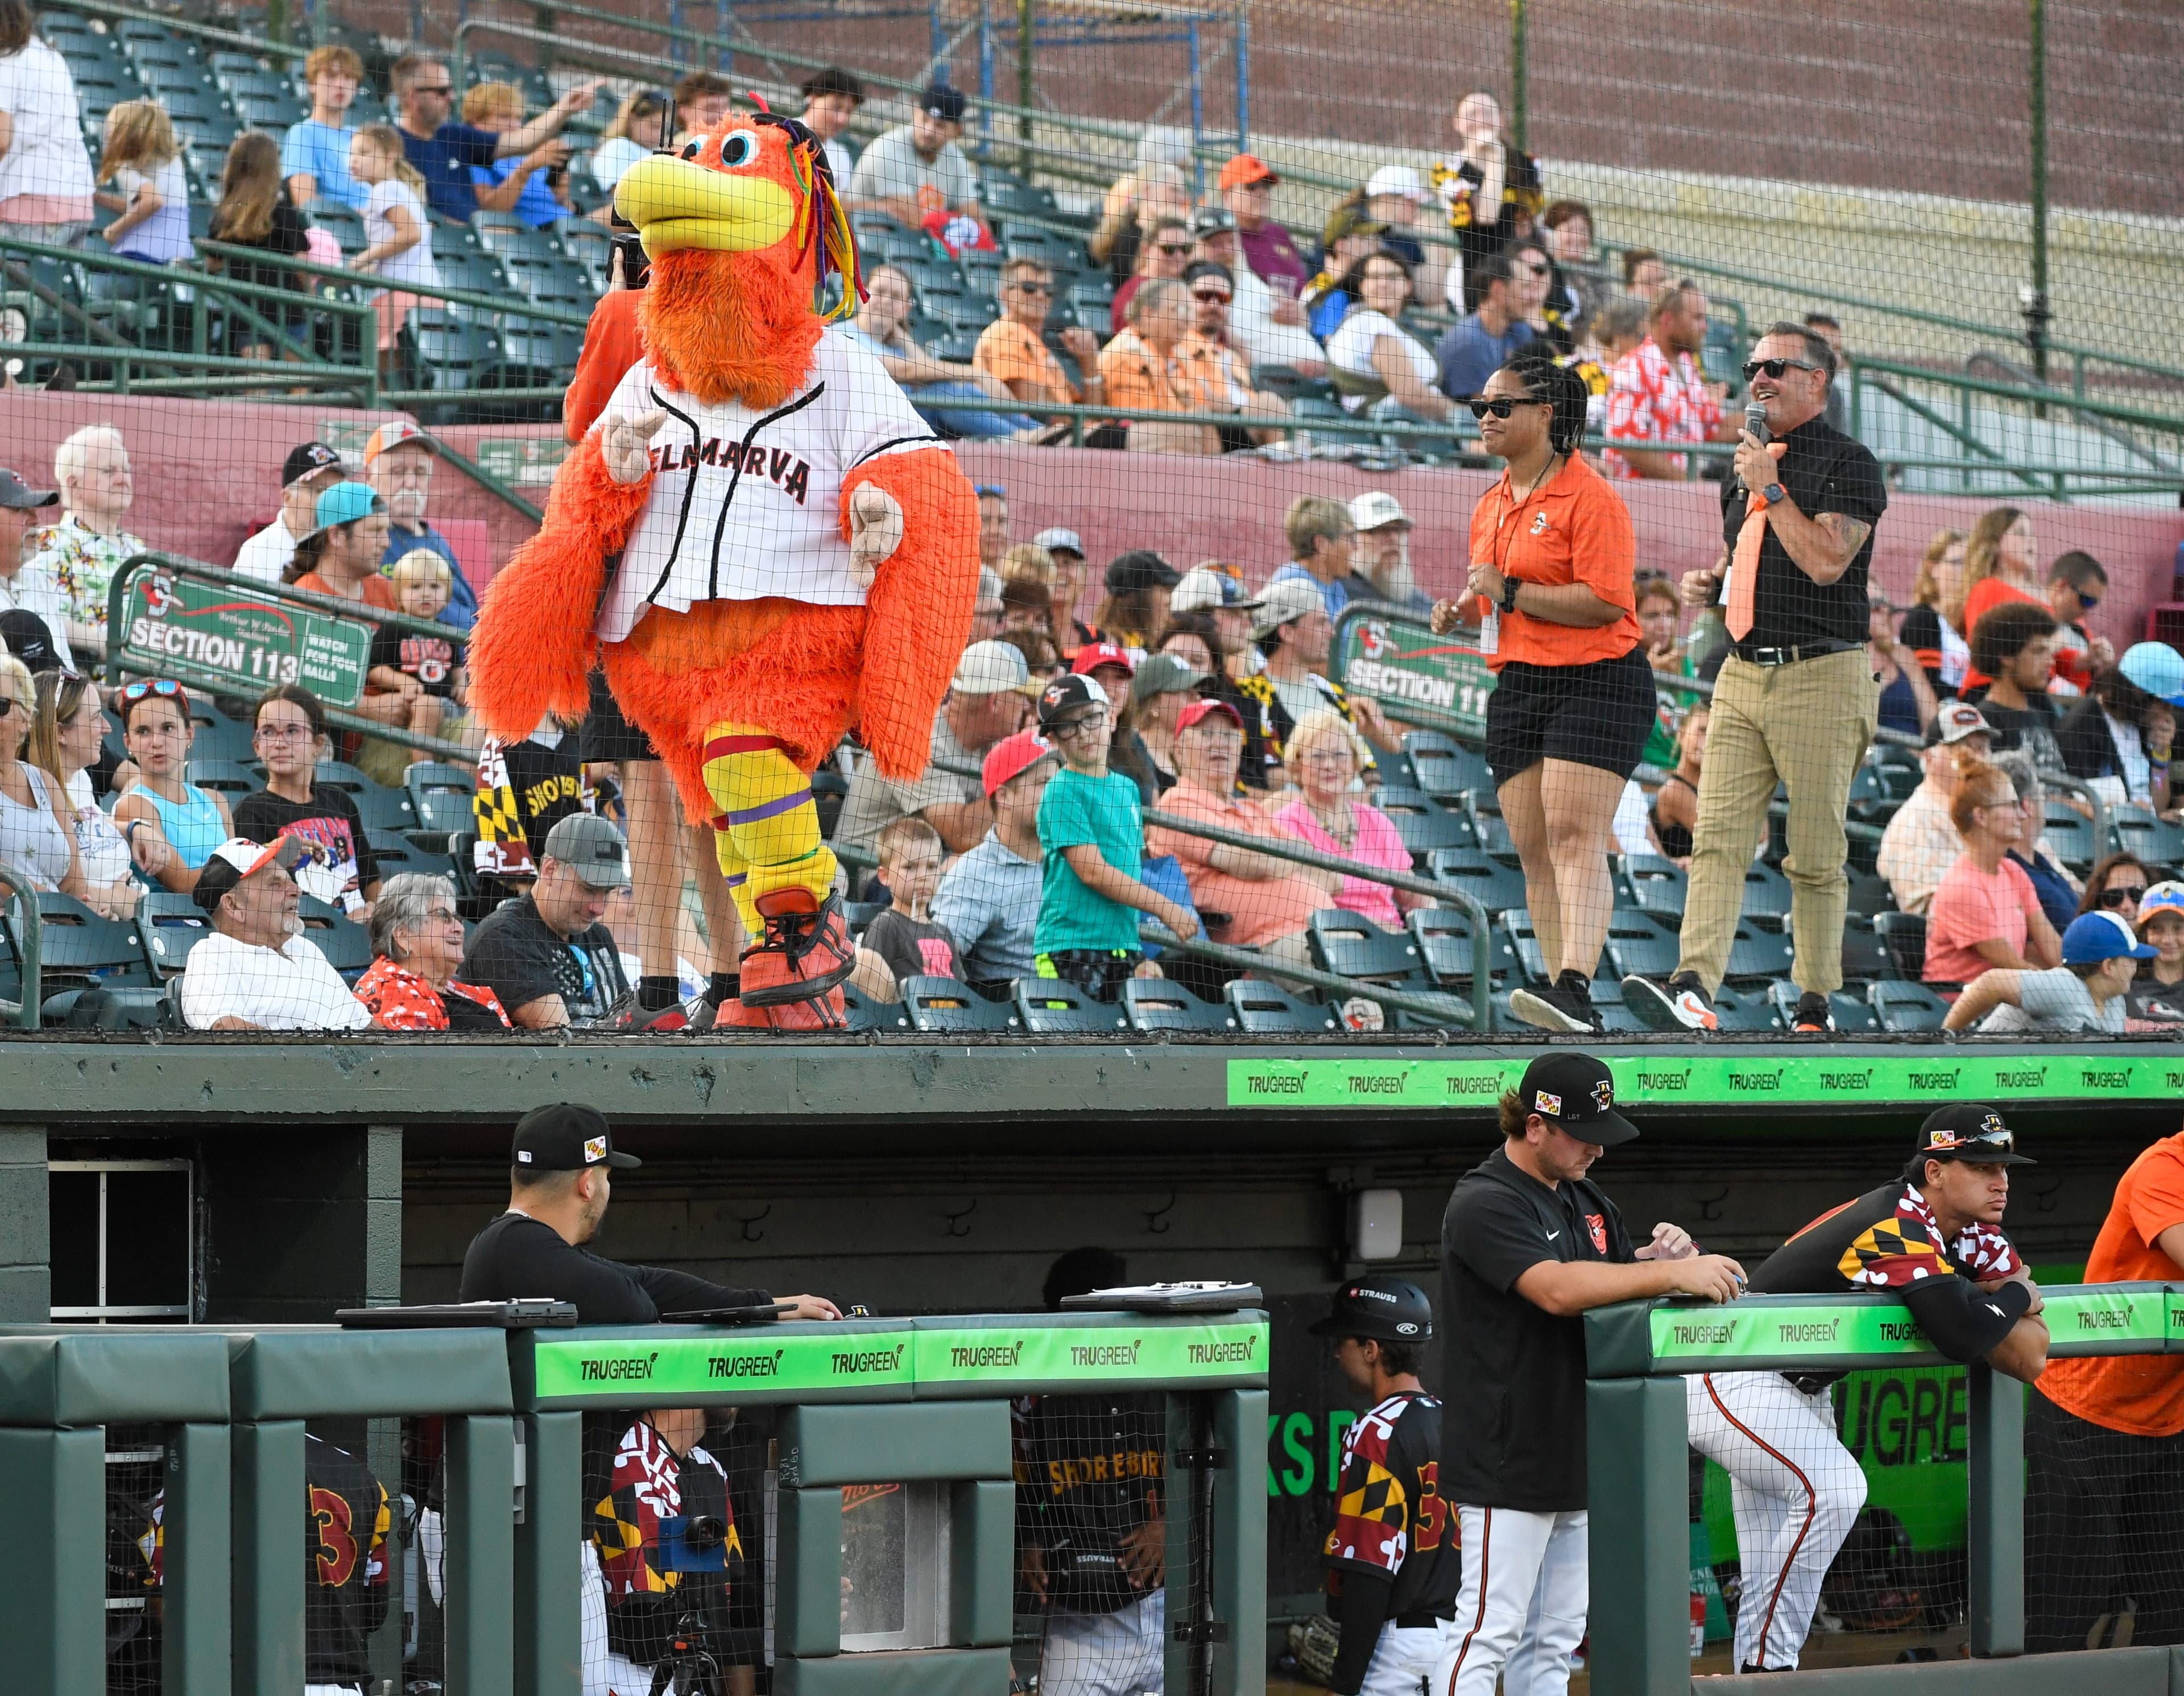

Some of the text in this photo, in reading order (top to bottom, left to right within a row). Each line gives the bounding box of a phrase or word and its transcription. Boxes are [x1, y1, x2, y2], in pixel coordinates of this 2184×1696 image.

[130, 617, 299, 684] SECTION 113
[305, 648, 329, 665] FOR
[303, 663, 337, 682] BALLS
[1348, 659, 1456, 709] SECTION
[1248, 1076, 1304, 1093] TRUGREEN
[1349, 1076, 1404, 1093] TRUGREEN
[1447, 1076, 1500, 1093] TRUGREEN
[1637, 1073, 1687, 1090] TRUGREEN
[1728, 1073, 1780, 1090] TRUGREEN
[1820, 1073, 1869, 1090] TRUGREEN
[1908, 1073, 1958, 1089] TRUGREEN
[1996, 1072, 2044, 1089] TRUGREEN
[2082, 1072, 2129, 1088] TRUGREEN
[1359, 1289, 1397, 1303] STRAUSS
[2078, 1310, 2130, 1329] TRUGREEN
[1674, 1325, 1734, 1344] TRUGREEN
[1779, 1324, 1837, 1343] TRUGREEN
[951, 1347, 1020, 1367] TRUGREEN
[1071, 1346, 1139, 1366] TRUGREEN
[1188, 1342, 1254, 1364] TRUGREEN
[581, 1359, 653, 1380] TRUGREEN
[708, 1357, 779, 1378] TRUGREEN
[832, 1353, 900, 1375] TRUGREEN
[1048, 1450, 1165, 1496] SHOREBIR
[309, 1483, 359, 1588] 3
[1077, 1554, 1115, 1563] STRAUSS
